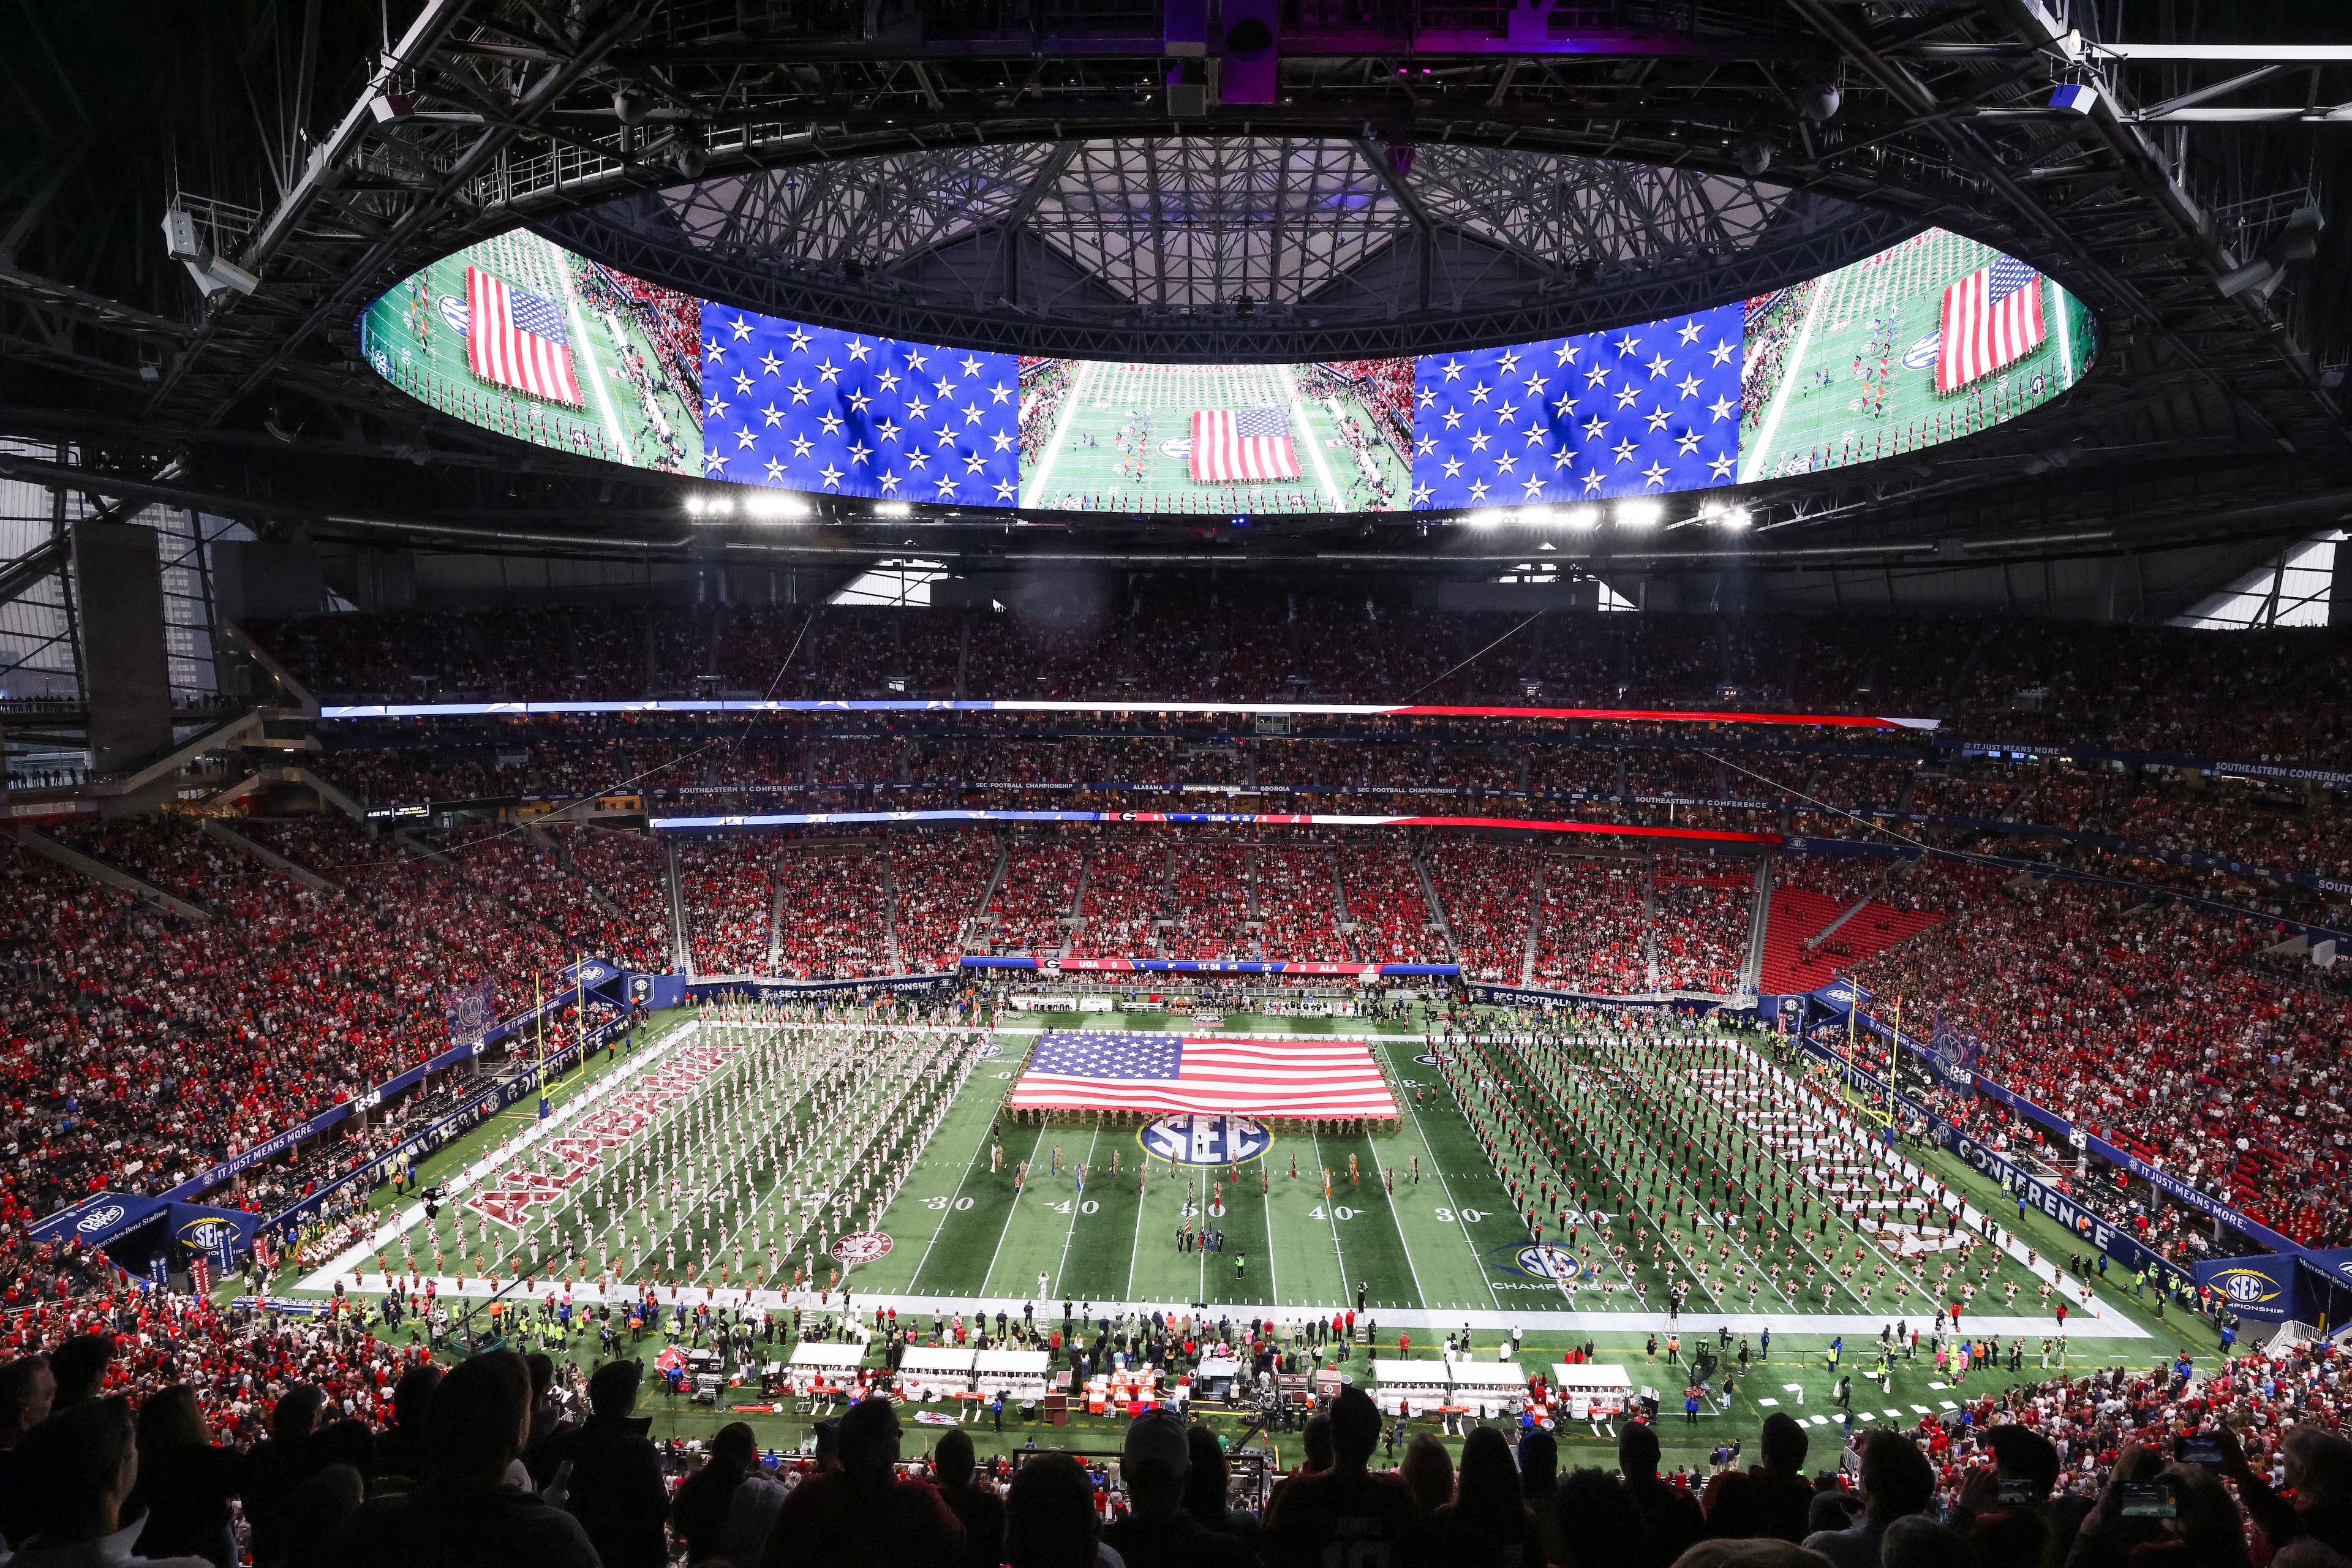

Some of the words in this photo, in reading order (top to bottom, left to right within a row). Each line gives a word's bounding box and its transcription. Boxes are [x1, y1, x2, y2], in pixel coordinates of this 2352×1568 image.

[2215, 761, 2286, 777] SOUTHEASTERN
[1635, 796, 1695, 805] SOUTHEASTERN
[1707, 800, 1767, 809] CONFERENCE
[778, 990, 798, 998] SEC
[511, 1020, 516, 1029] IT
[517, 1015, 529, 1026] JUST
[456, 1021, 491, 1046] Allstate
[1881, 1025, 1893, 1036] JUST
[473, 1039, 484, 1053] 25
[1950, 1065, 1972, 1085] 12:58
[355, 1090, 381, 1112] 12:58
[1151, 1115, 1262, 1163] SEC
[2071, 1129, 2085, 1148] 25
[217, 1169, 226, 1179] IT
[227, 1155, 251, 1175] JUST
[254, 1139, 285, 1159] MEANS
[2141, 1165, 2150, 1177] IT
[2150, 1168, 2174, 1190] JUST
[2175, 1183, 2210, 1210] MEANS
[76, 1195, 111, 1213] CONFERENCE
[927, 1196, 974, 1212] 30
[1053, 1200, 1100, 1215] 40
[1181, 1203, 1226, 1218] 50
[1308, 1205, 1354, 1221] 40
[1435, 1208, 1482, 1223] 30
[1566, 1210, 1610, 1225] 20
[1686, 1211, 1738, 1226] 10
[92, 1222, 142, 1251] Mercedes-Benz
[142, 1208, 168, 1227] Stadium
[193, 1223, 218, 1249] SE
[2299, 1257, 2349, 1290] Mercedes-Benz
[2228, 1275, 2260, 1301] SEC
